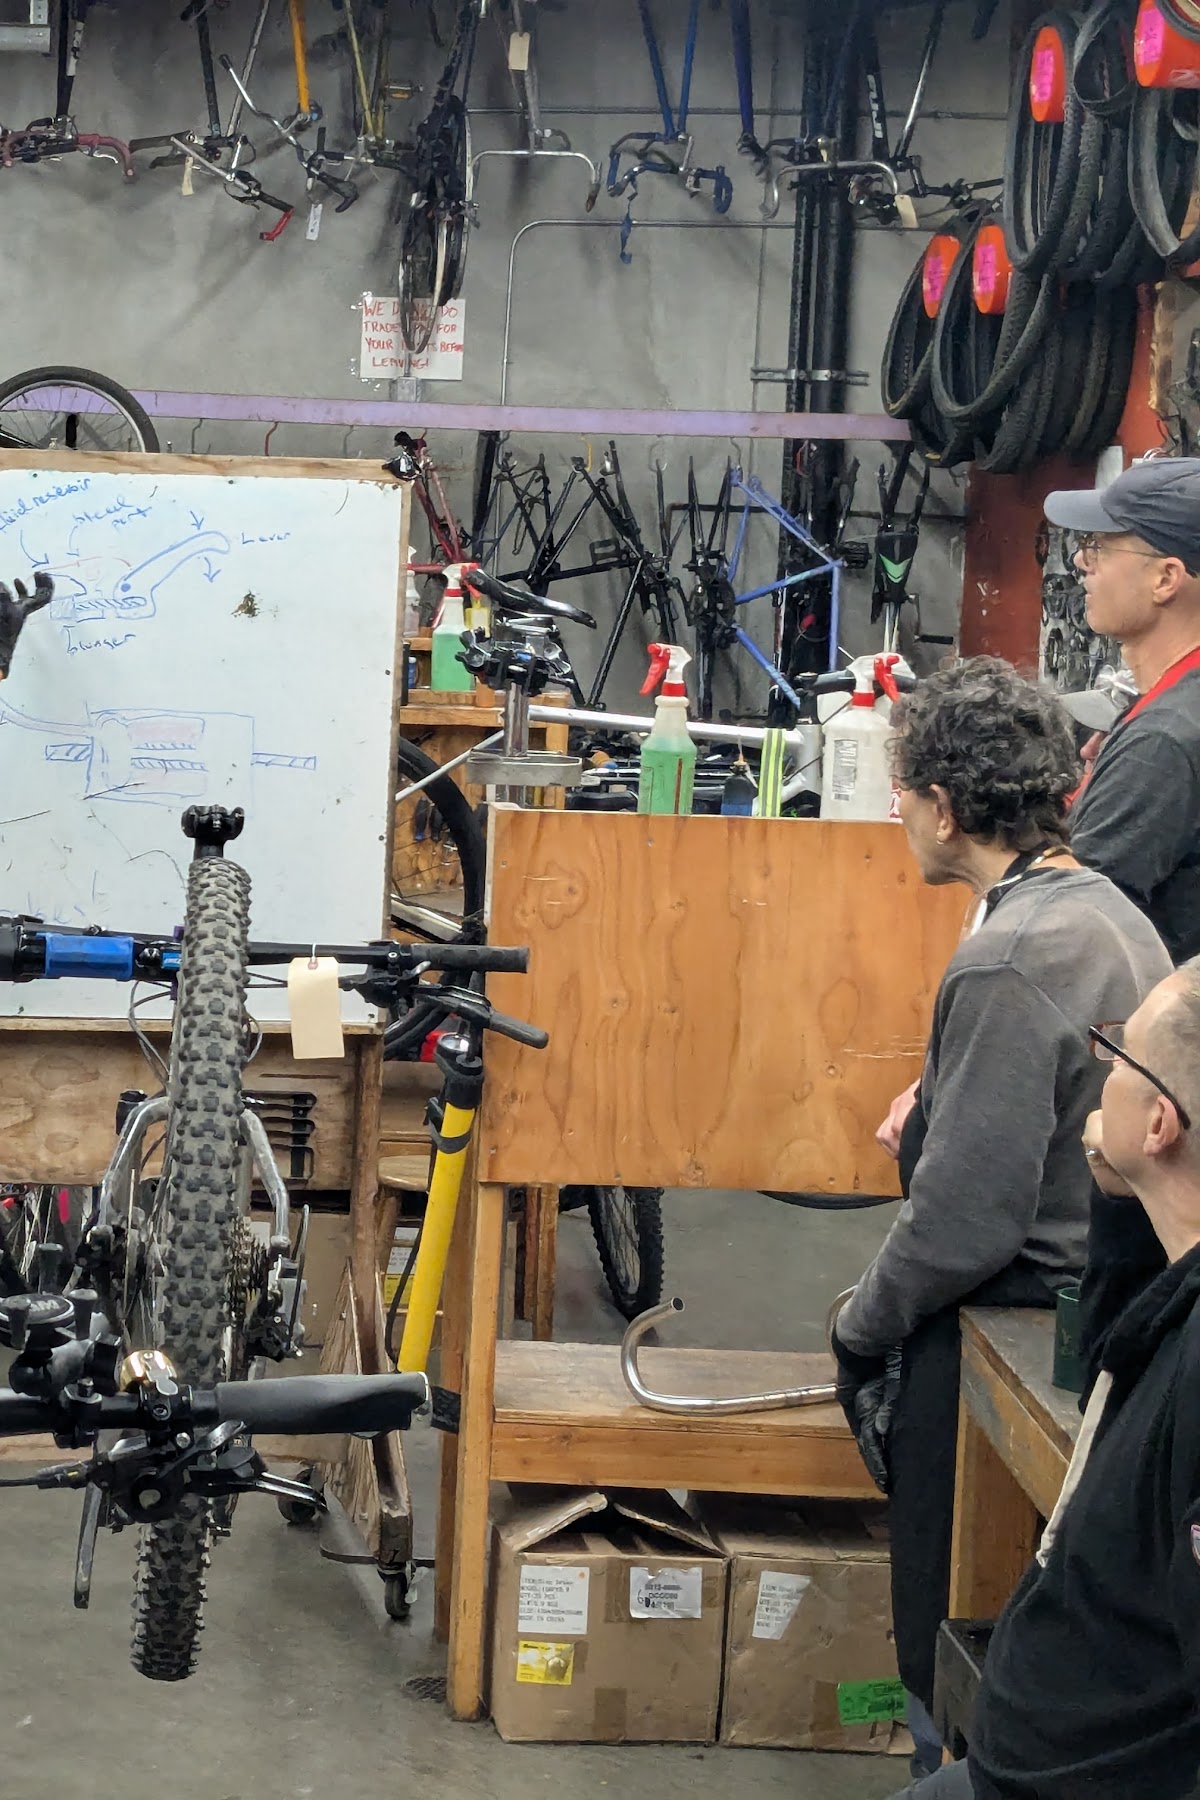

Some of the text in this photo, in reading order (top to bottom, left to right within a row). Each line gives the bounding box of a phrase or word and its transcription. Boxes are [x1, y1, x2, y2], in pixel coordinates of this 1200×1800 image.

[364, 301, 385, 316] WE
[441, 306, 458, 318] DO
[437, 324, 457, 333] FOR
[365, 337, 393, 352] YOUR
[372, 357, 429, 369] LEAVNG!
